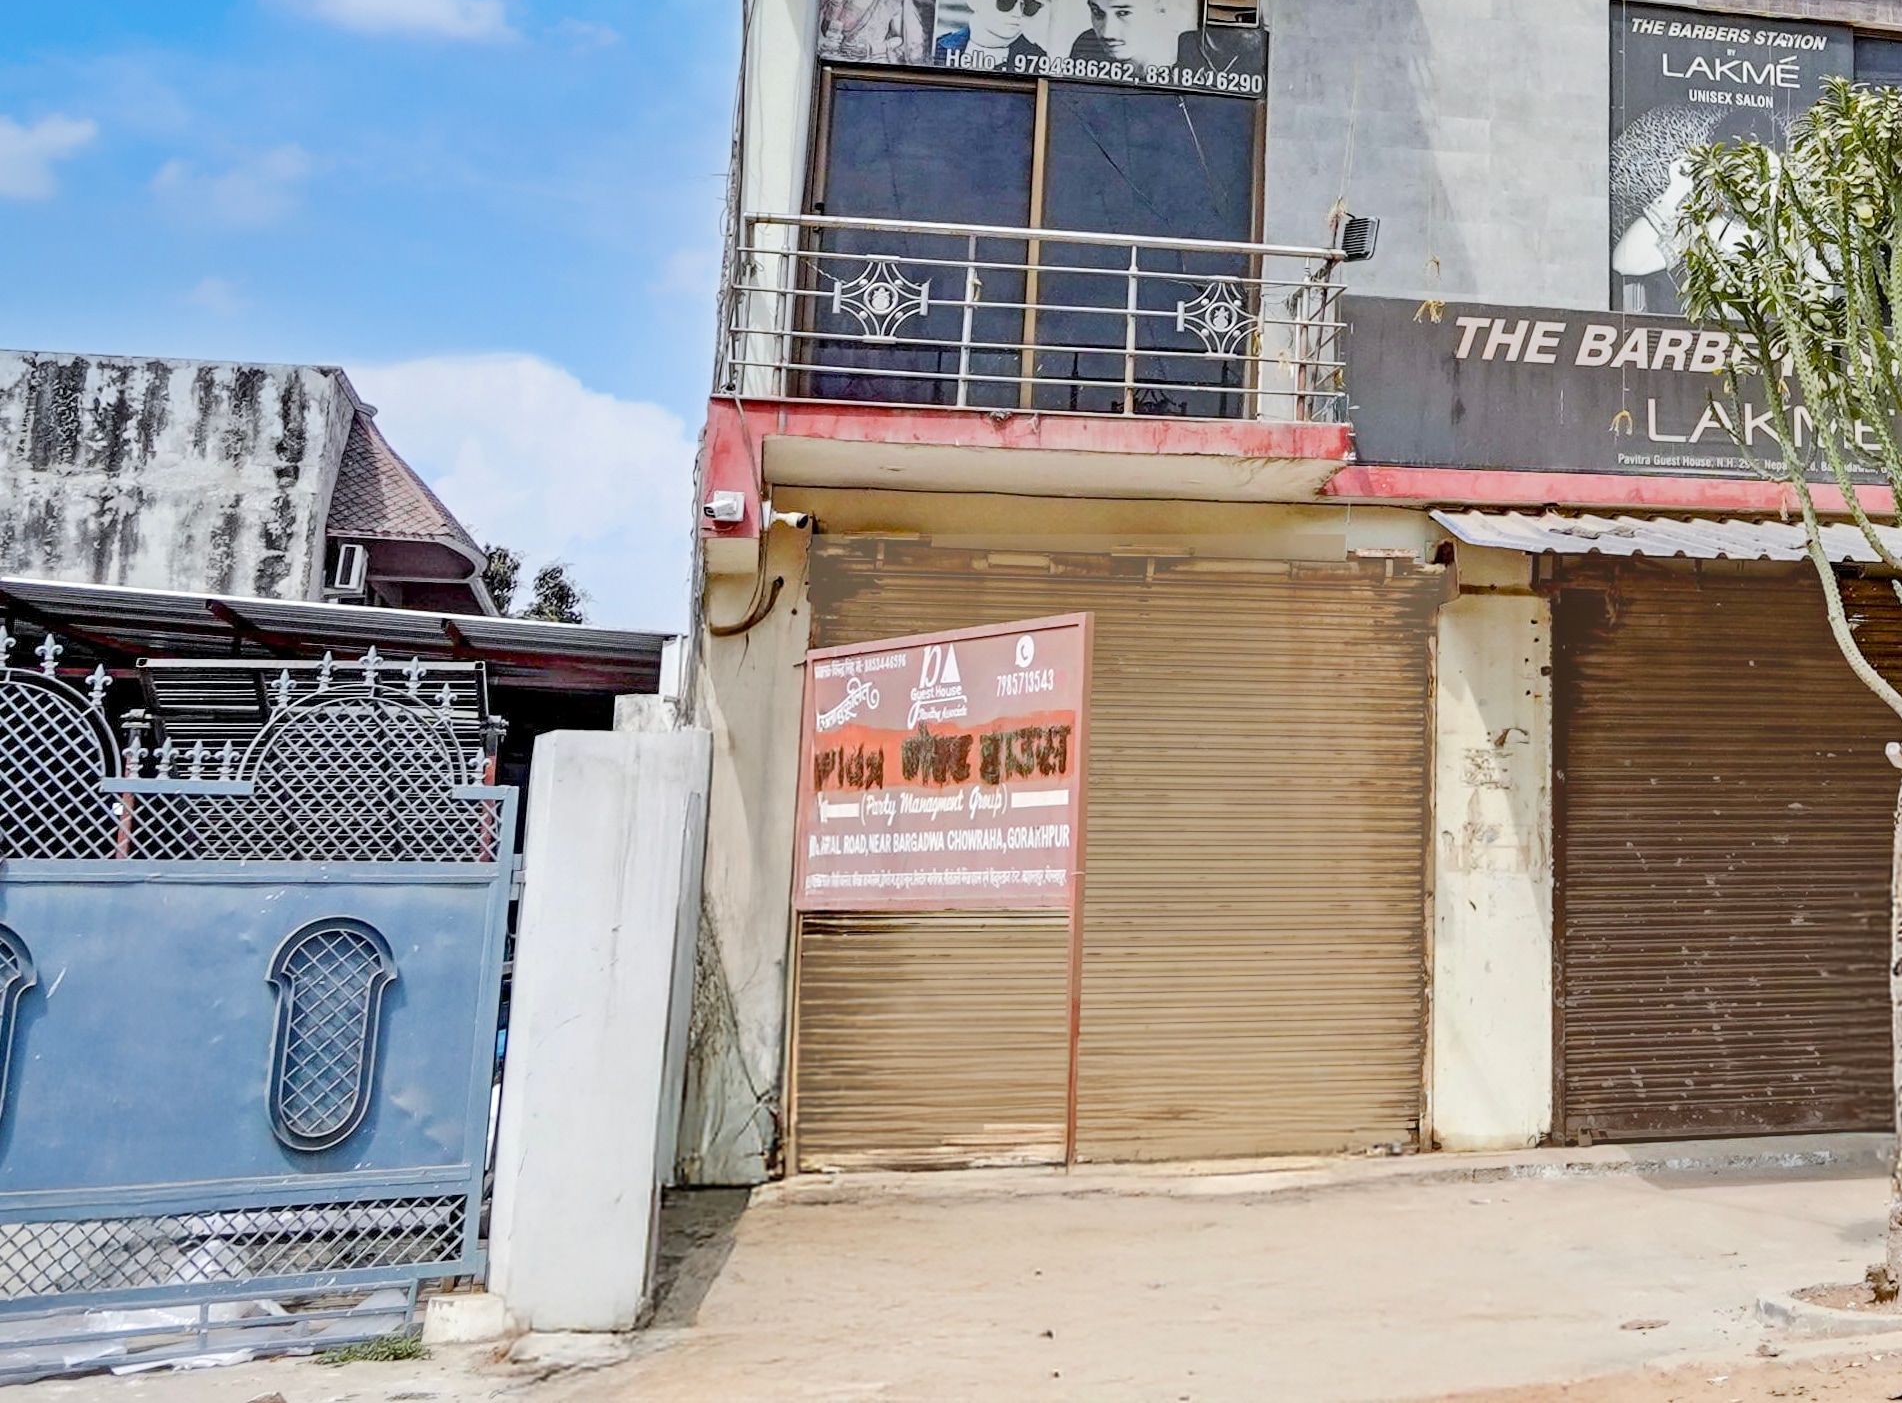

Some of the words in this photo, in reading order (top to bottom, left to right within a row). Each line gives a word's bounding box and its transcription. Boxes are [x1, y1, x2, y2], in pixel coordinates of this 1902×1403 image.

[1631, 18, 1666, 36] THE
[1667, 22, 1751, 45] BARBERS
[1753, 30, 1827, 51] STATION
[945, 48, 995, 71] Hello
[1014, 54, 1139, 85] 9794386262,
[1726, 48, 1736, 57] BY
[1661, 52, 1801, 89] LAKMÉ
[1688, 88, 1733, 105] UNISEX
[1735, 93, 1774, 109] SALON
[1454, 316, 1567, 365] THE
[1574, 323, 1825, 380] BARBE
[1617, 453, 1651, 465] Pavitra
[1653, 454, 1681, 467] Guest
[1682, 455, 1714, 469] House,
[1764, 459, 1792, 472] Nepa
[910, 686, 935, 702] Guest
[935, 683, 963, 698] House
[996, 668, 1055, 697] 7985713543
[892, 830, 945, 853] BARGADWA
[947, 827, 1006, 854] CHOWRAHA,
[1007, 824, 1070, 849] GORAKHPUR
